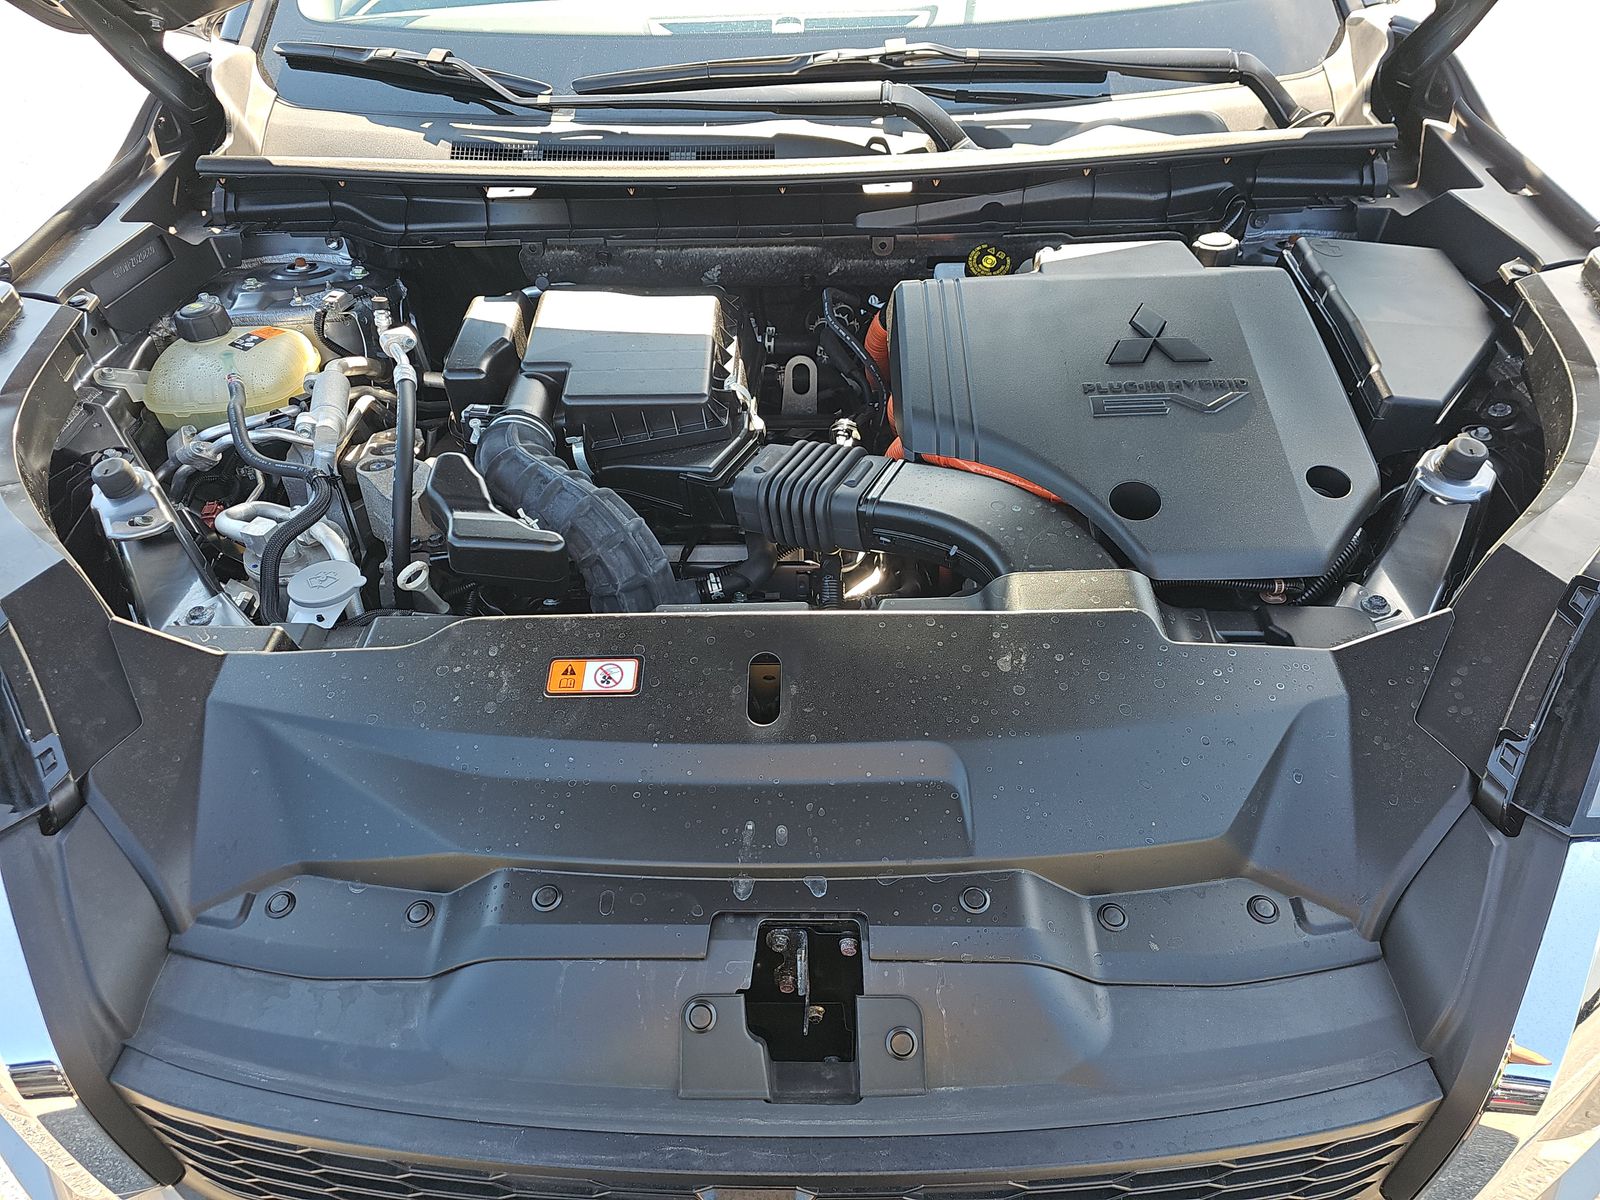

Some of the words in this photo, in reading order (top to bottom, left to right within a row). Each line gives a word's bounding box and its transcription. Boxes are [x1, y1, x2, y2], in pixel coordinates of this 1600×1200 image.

[1082, 379, 1166, 394] PLUG-IN
[1167, 377, 1249, 392] HYBRID
[1089, 391, 1250, 418] EV
